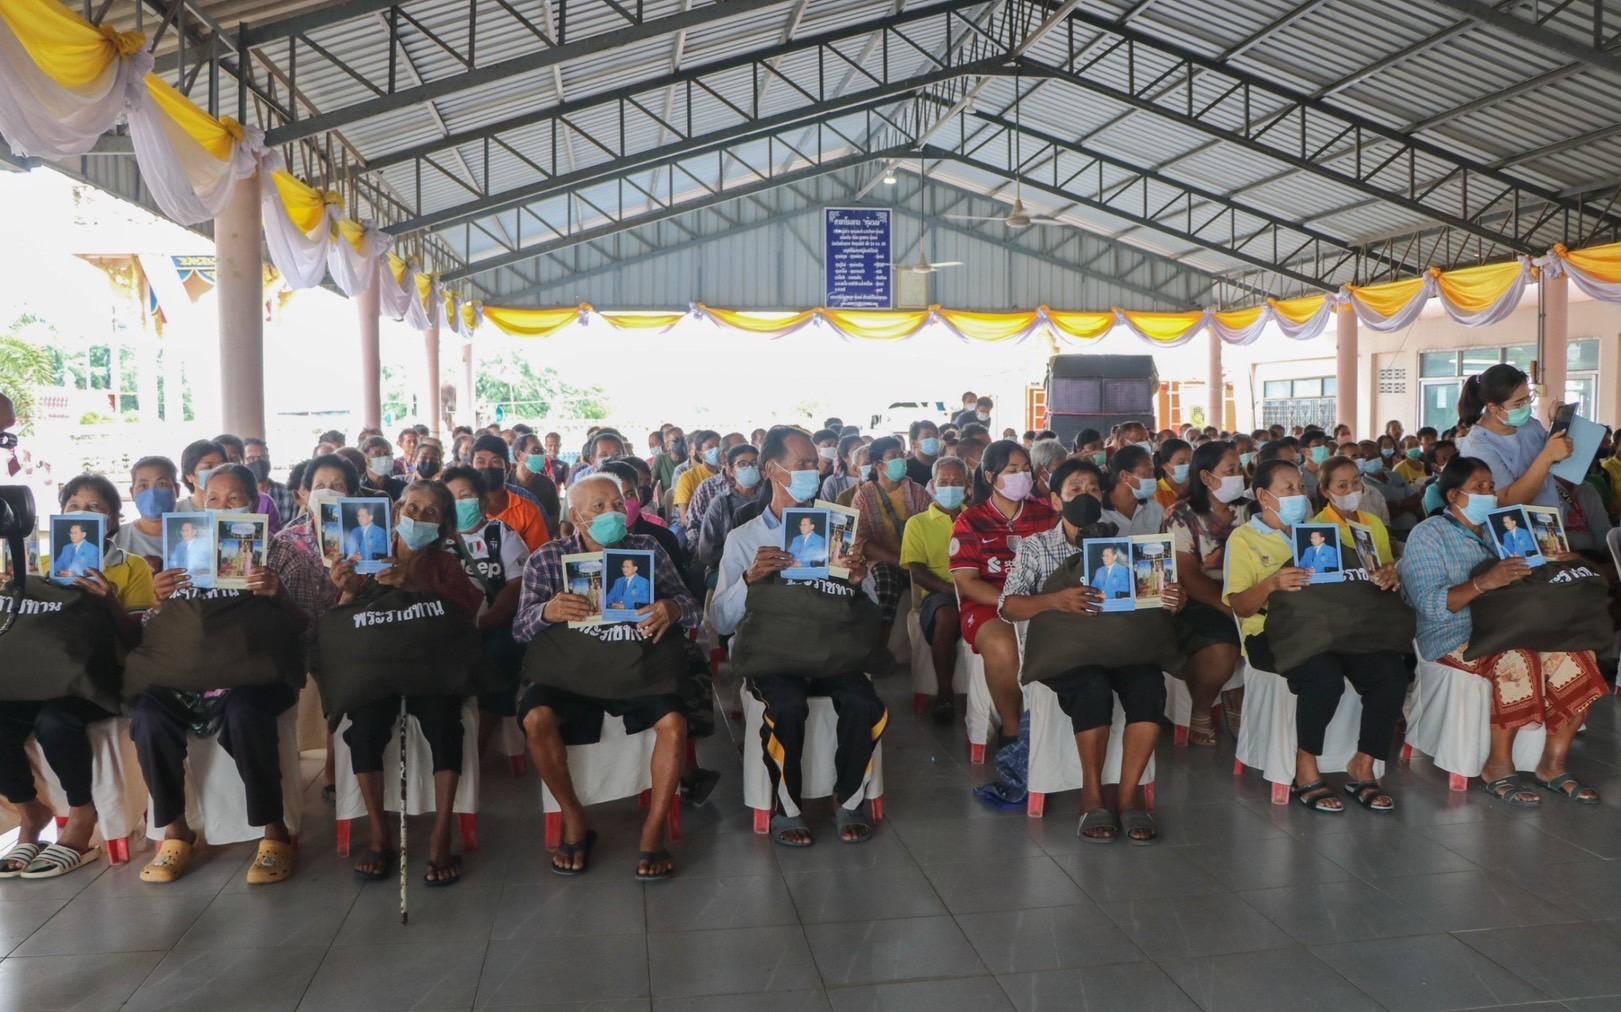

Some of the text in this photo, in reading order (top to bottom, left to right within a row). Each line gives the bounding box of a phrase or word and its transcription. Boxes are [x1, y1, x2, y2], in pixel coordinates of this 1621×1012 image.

[461, 560, 501, 578] eep
[353, 600, 445, 628] พระราชทาน
